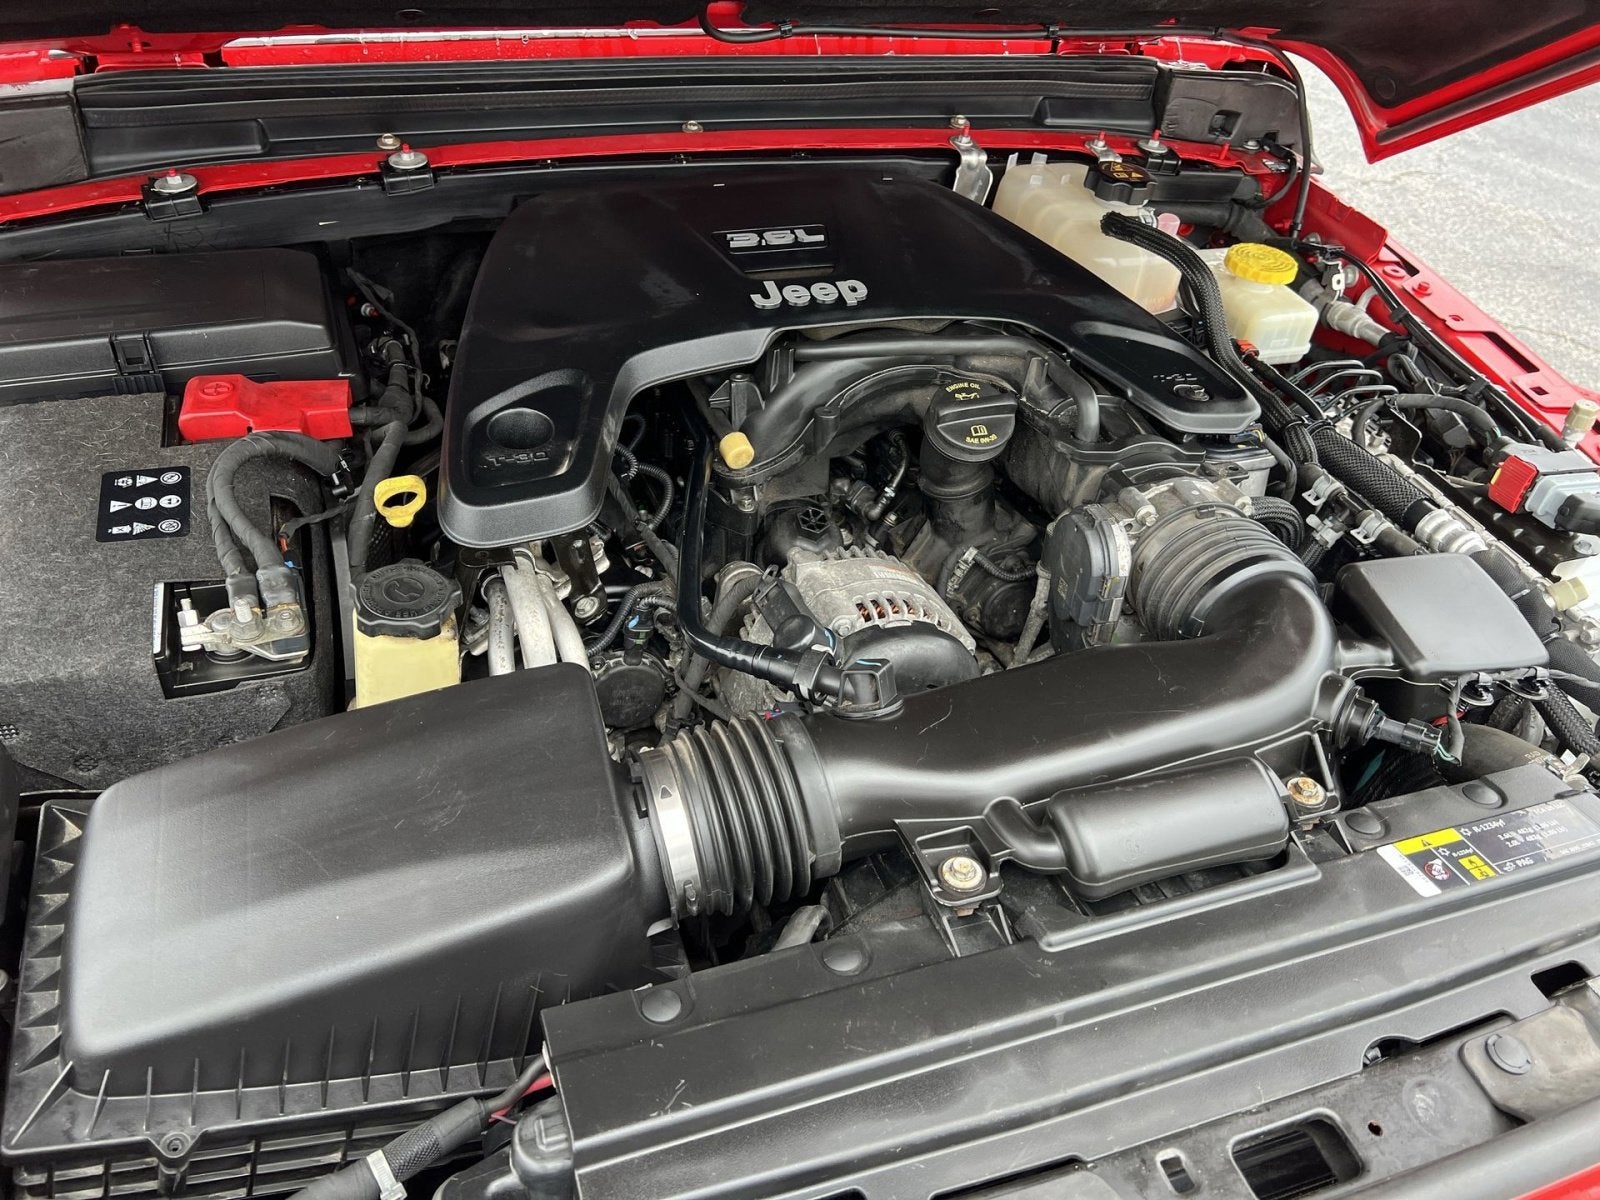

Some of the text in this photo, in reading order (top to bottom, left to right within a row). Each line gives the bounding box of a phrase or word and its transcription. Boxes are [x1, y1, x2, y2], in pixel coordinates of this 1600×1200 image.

[750, 279, 868, 309] Jeep
[945, 382, 981, 393] ENGINE OIL
[1516, 857, 1534, 868] PAG
